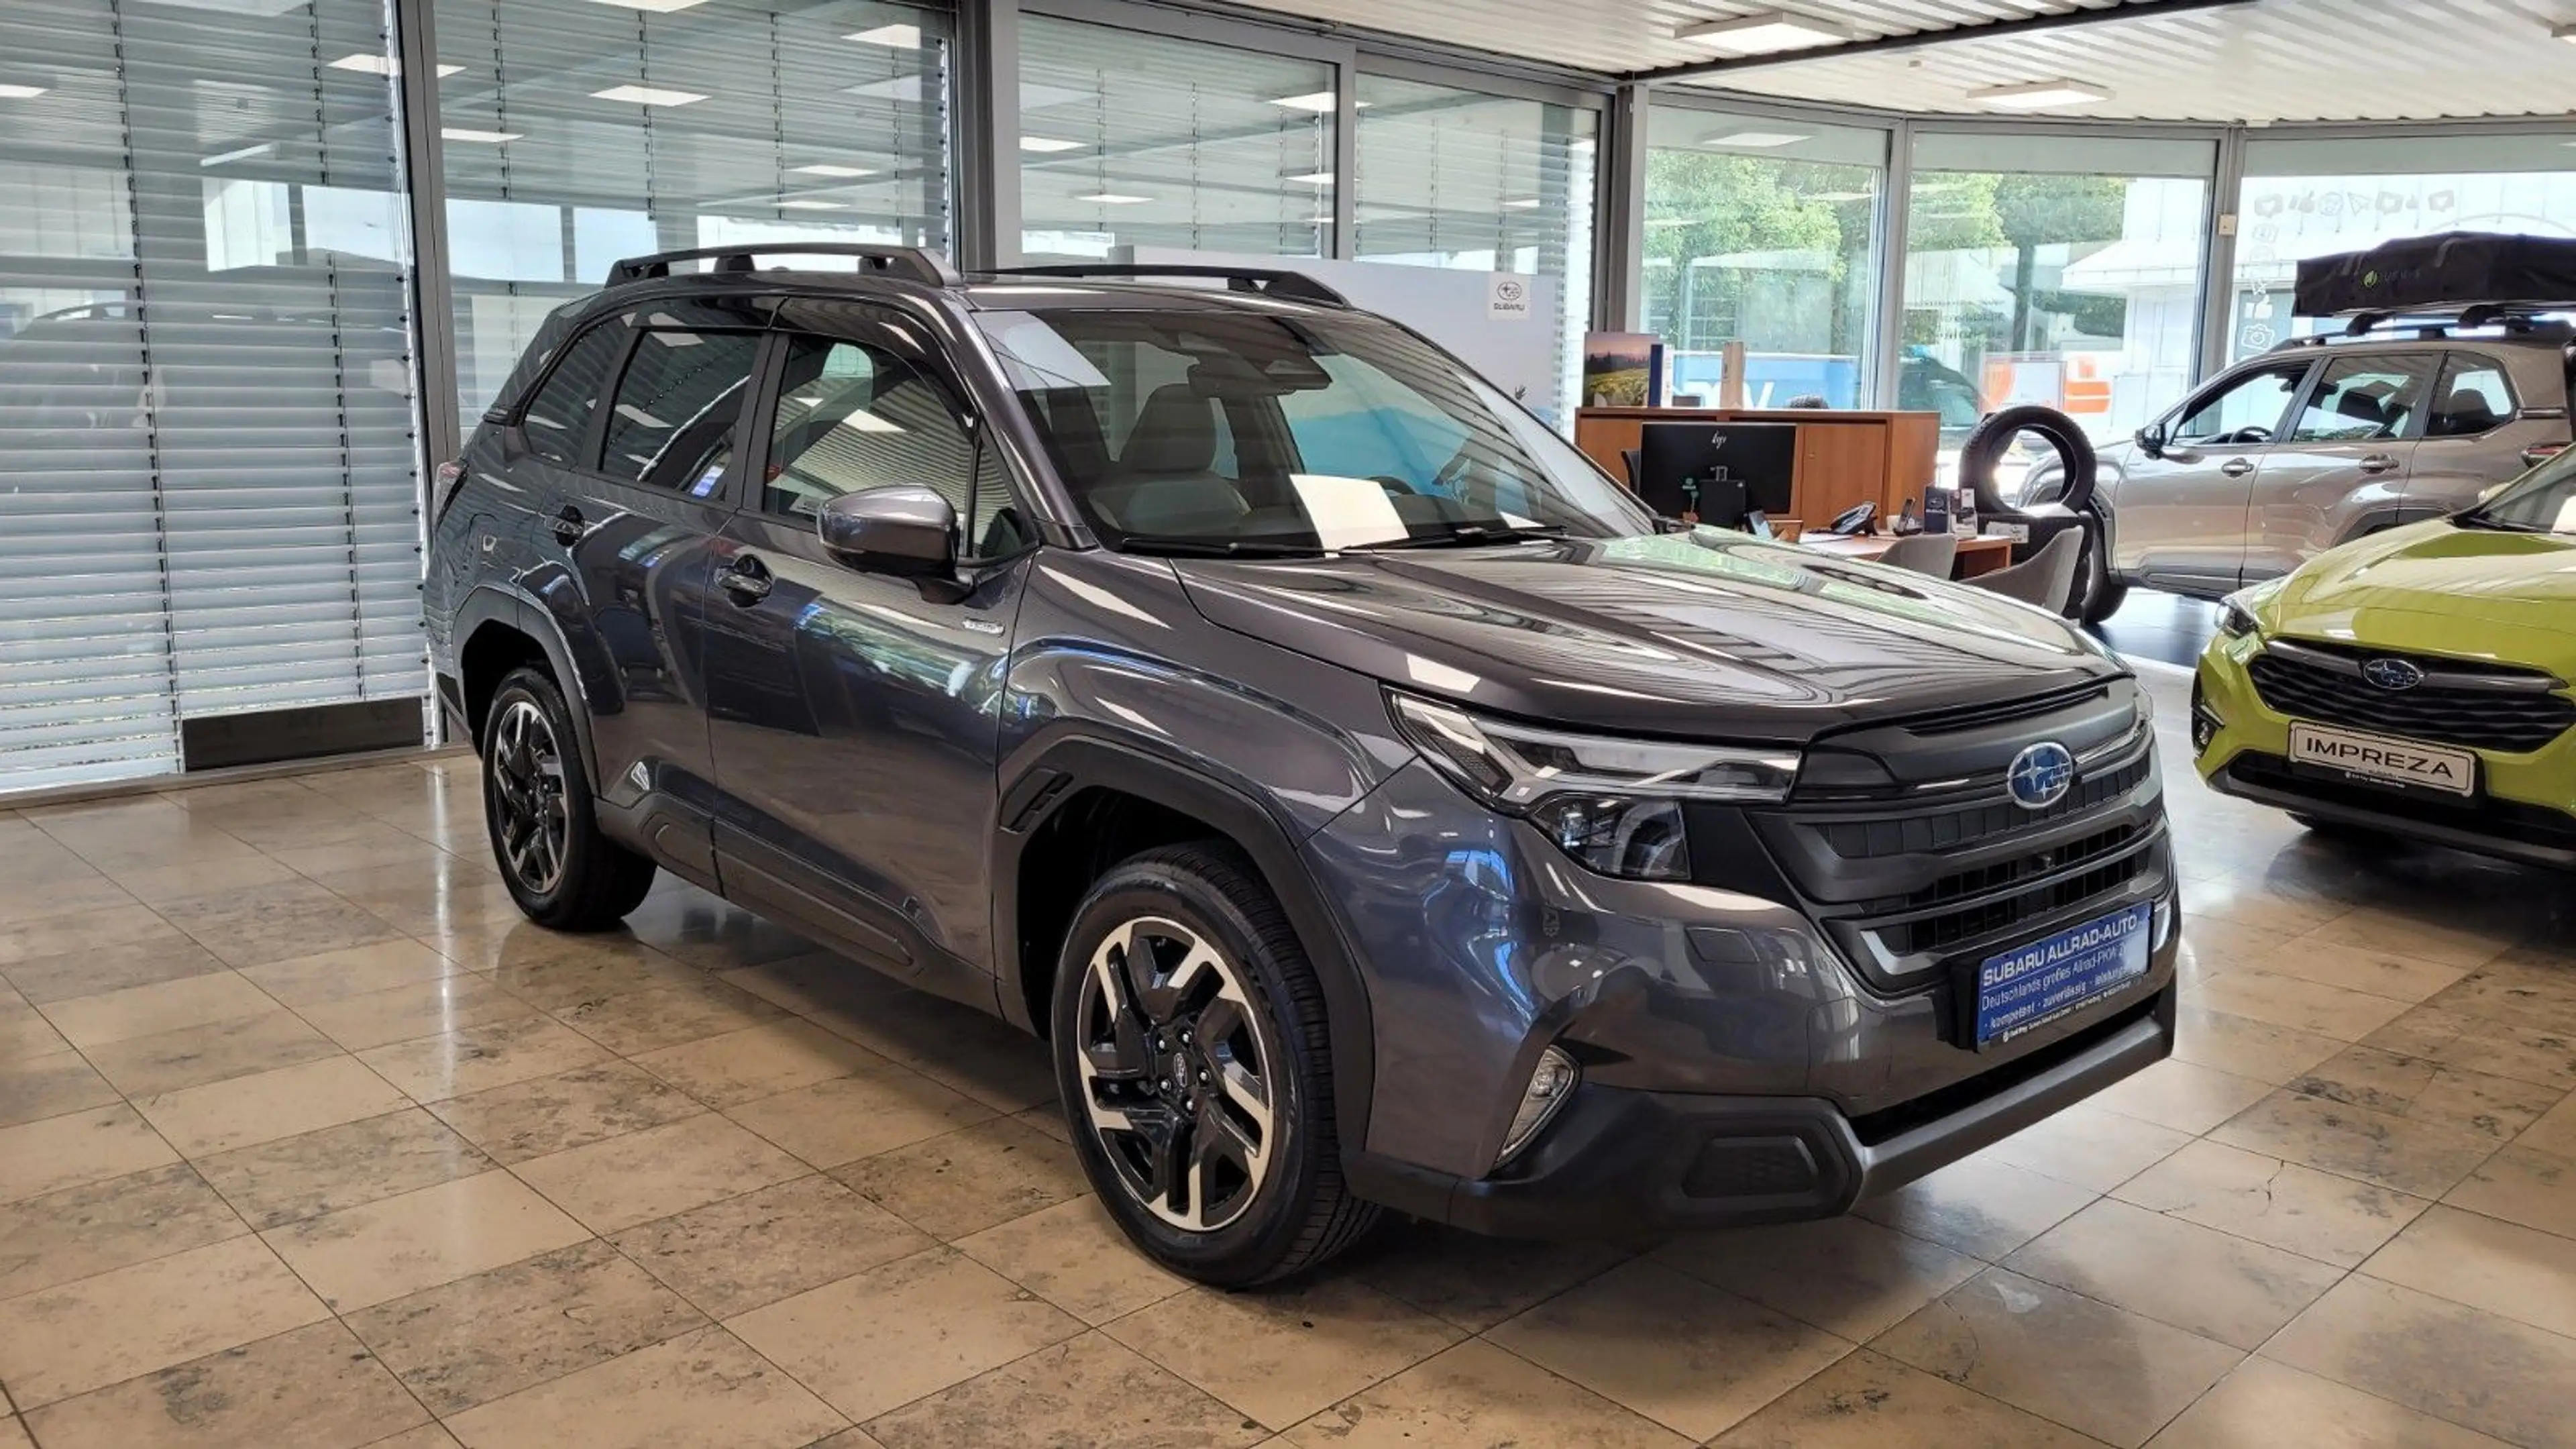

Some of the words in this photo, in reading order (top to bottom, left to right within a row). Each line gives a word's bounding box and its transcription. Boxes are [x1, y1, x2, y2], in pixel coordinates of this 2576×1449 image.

[1711, 429, 1727, 450] hp
[2306, 737, 2453, 779] IMPREZA
[1983, 951, 2045, 986] SUBARU
[2047, 914, 2137, 962] ALLRAD-AUTO
[1982, 978, 2042, 1012] Deutschlands
